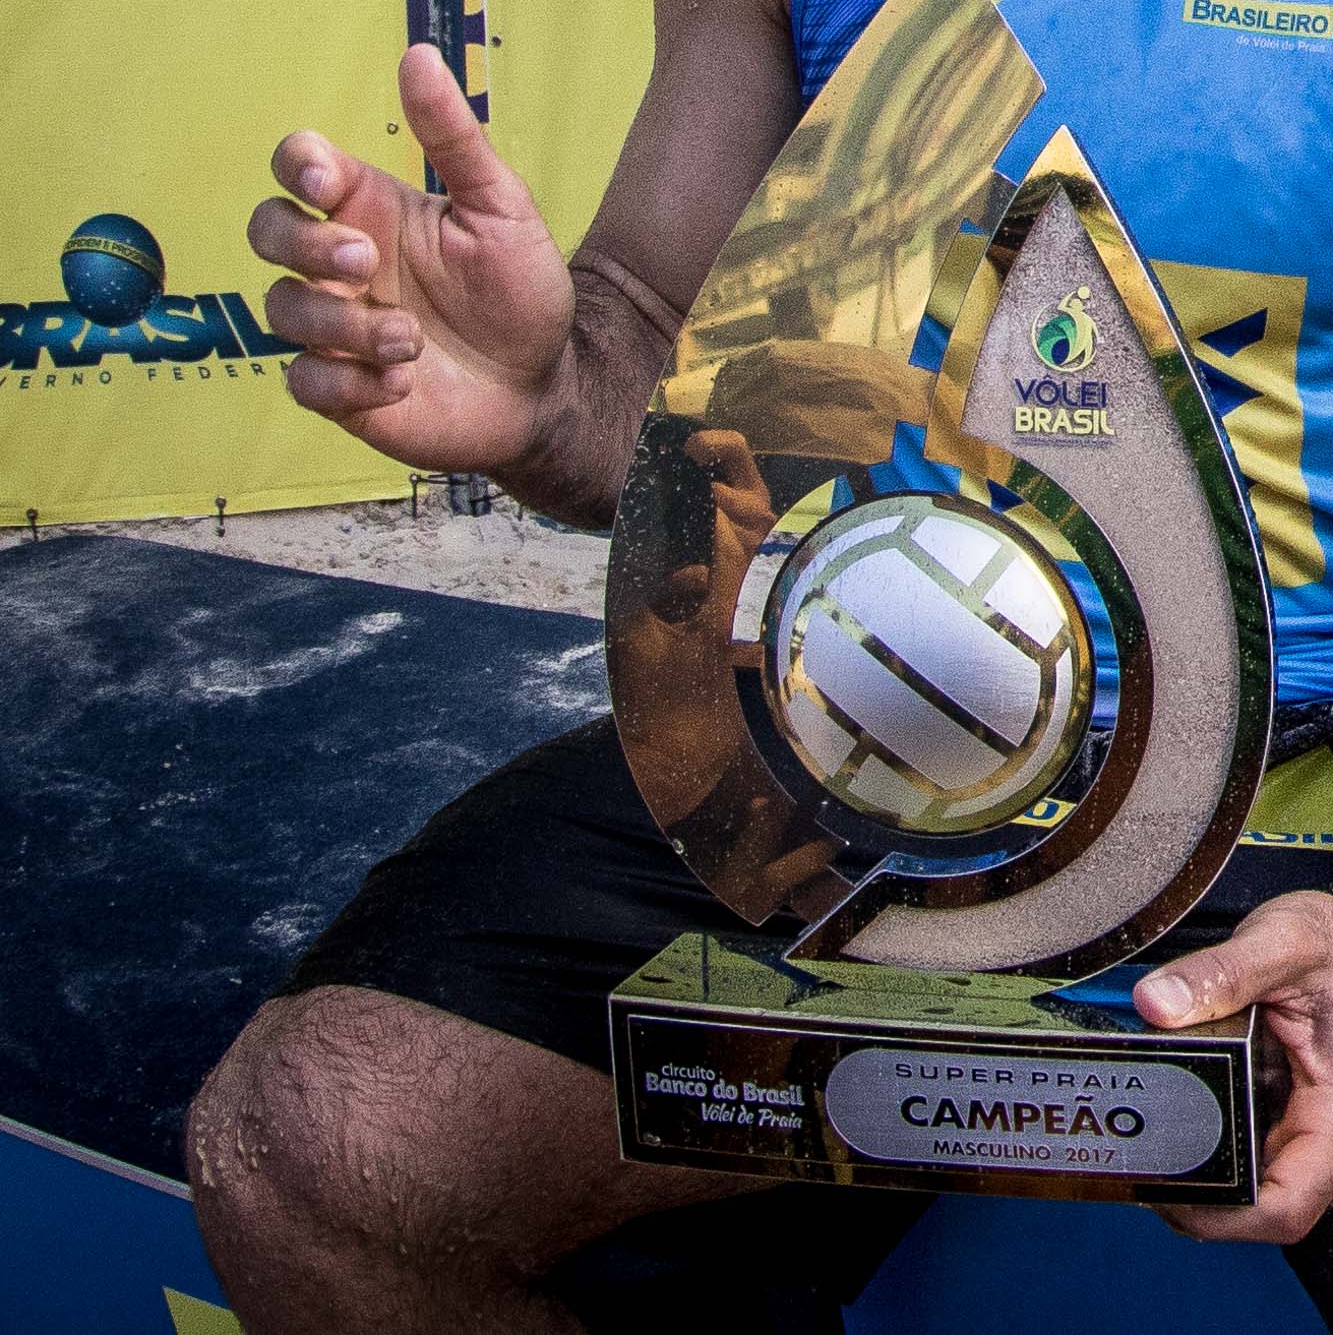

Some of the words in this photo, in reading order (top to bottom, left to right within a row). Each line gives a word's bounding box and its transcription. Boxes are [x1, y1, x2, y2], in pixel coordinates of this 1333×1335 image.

[147, 360, 290, 382] FEDER
[1014, 373, 1107, 408] VÔLEI
[1015, 406, 1116, 435] BRASIL
[661, 1063, 716, 1081] circuito
[896, 1064, 1015, 1085] SUPER
[1031, 1071, 1147, 1091] PRAIA
[645, 1071, 707, 1097] Banco
[713, 1078, 738, 1100] do
[743, 1081, 805, 1106] Brasil
[701, 1101, 736, 1122] Vôlei
[737, 1105, 754, 1125] de
[758, 1108, 803, 1129] Praia
[901, 1095, 1146, 1139] CAMPEÃO
[933, 1139, 1051, 1162] MASCULINO
[1066, 1145, 1116, 1164] 2017
